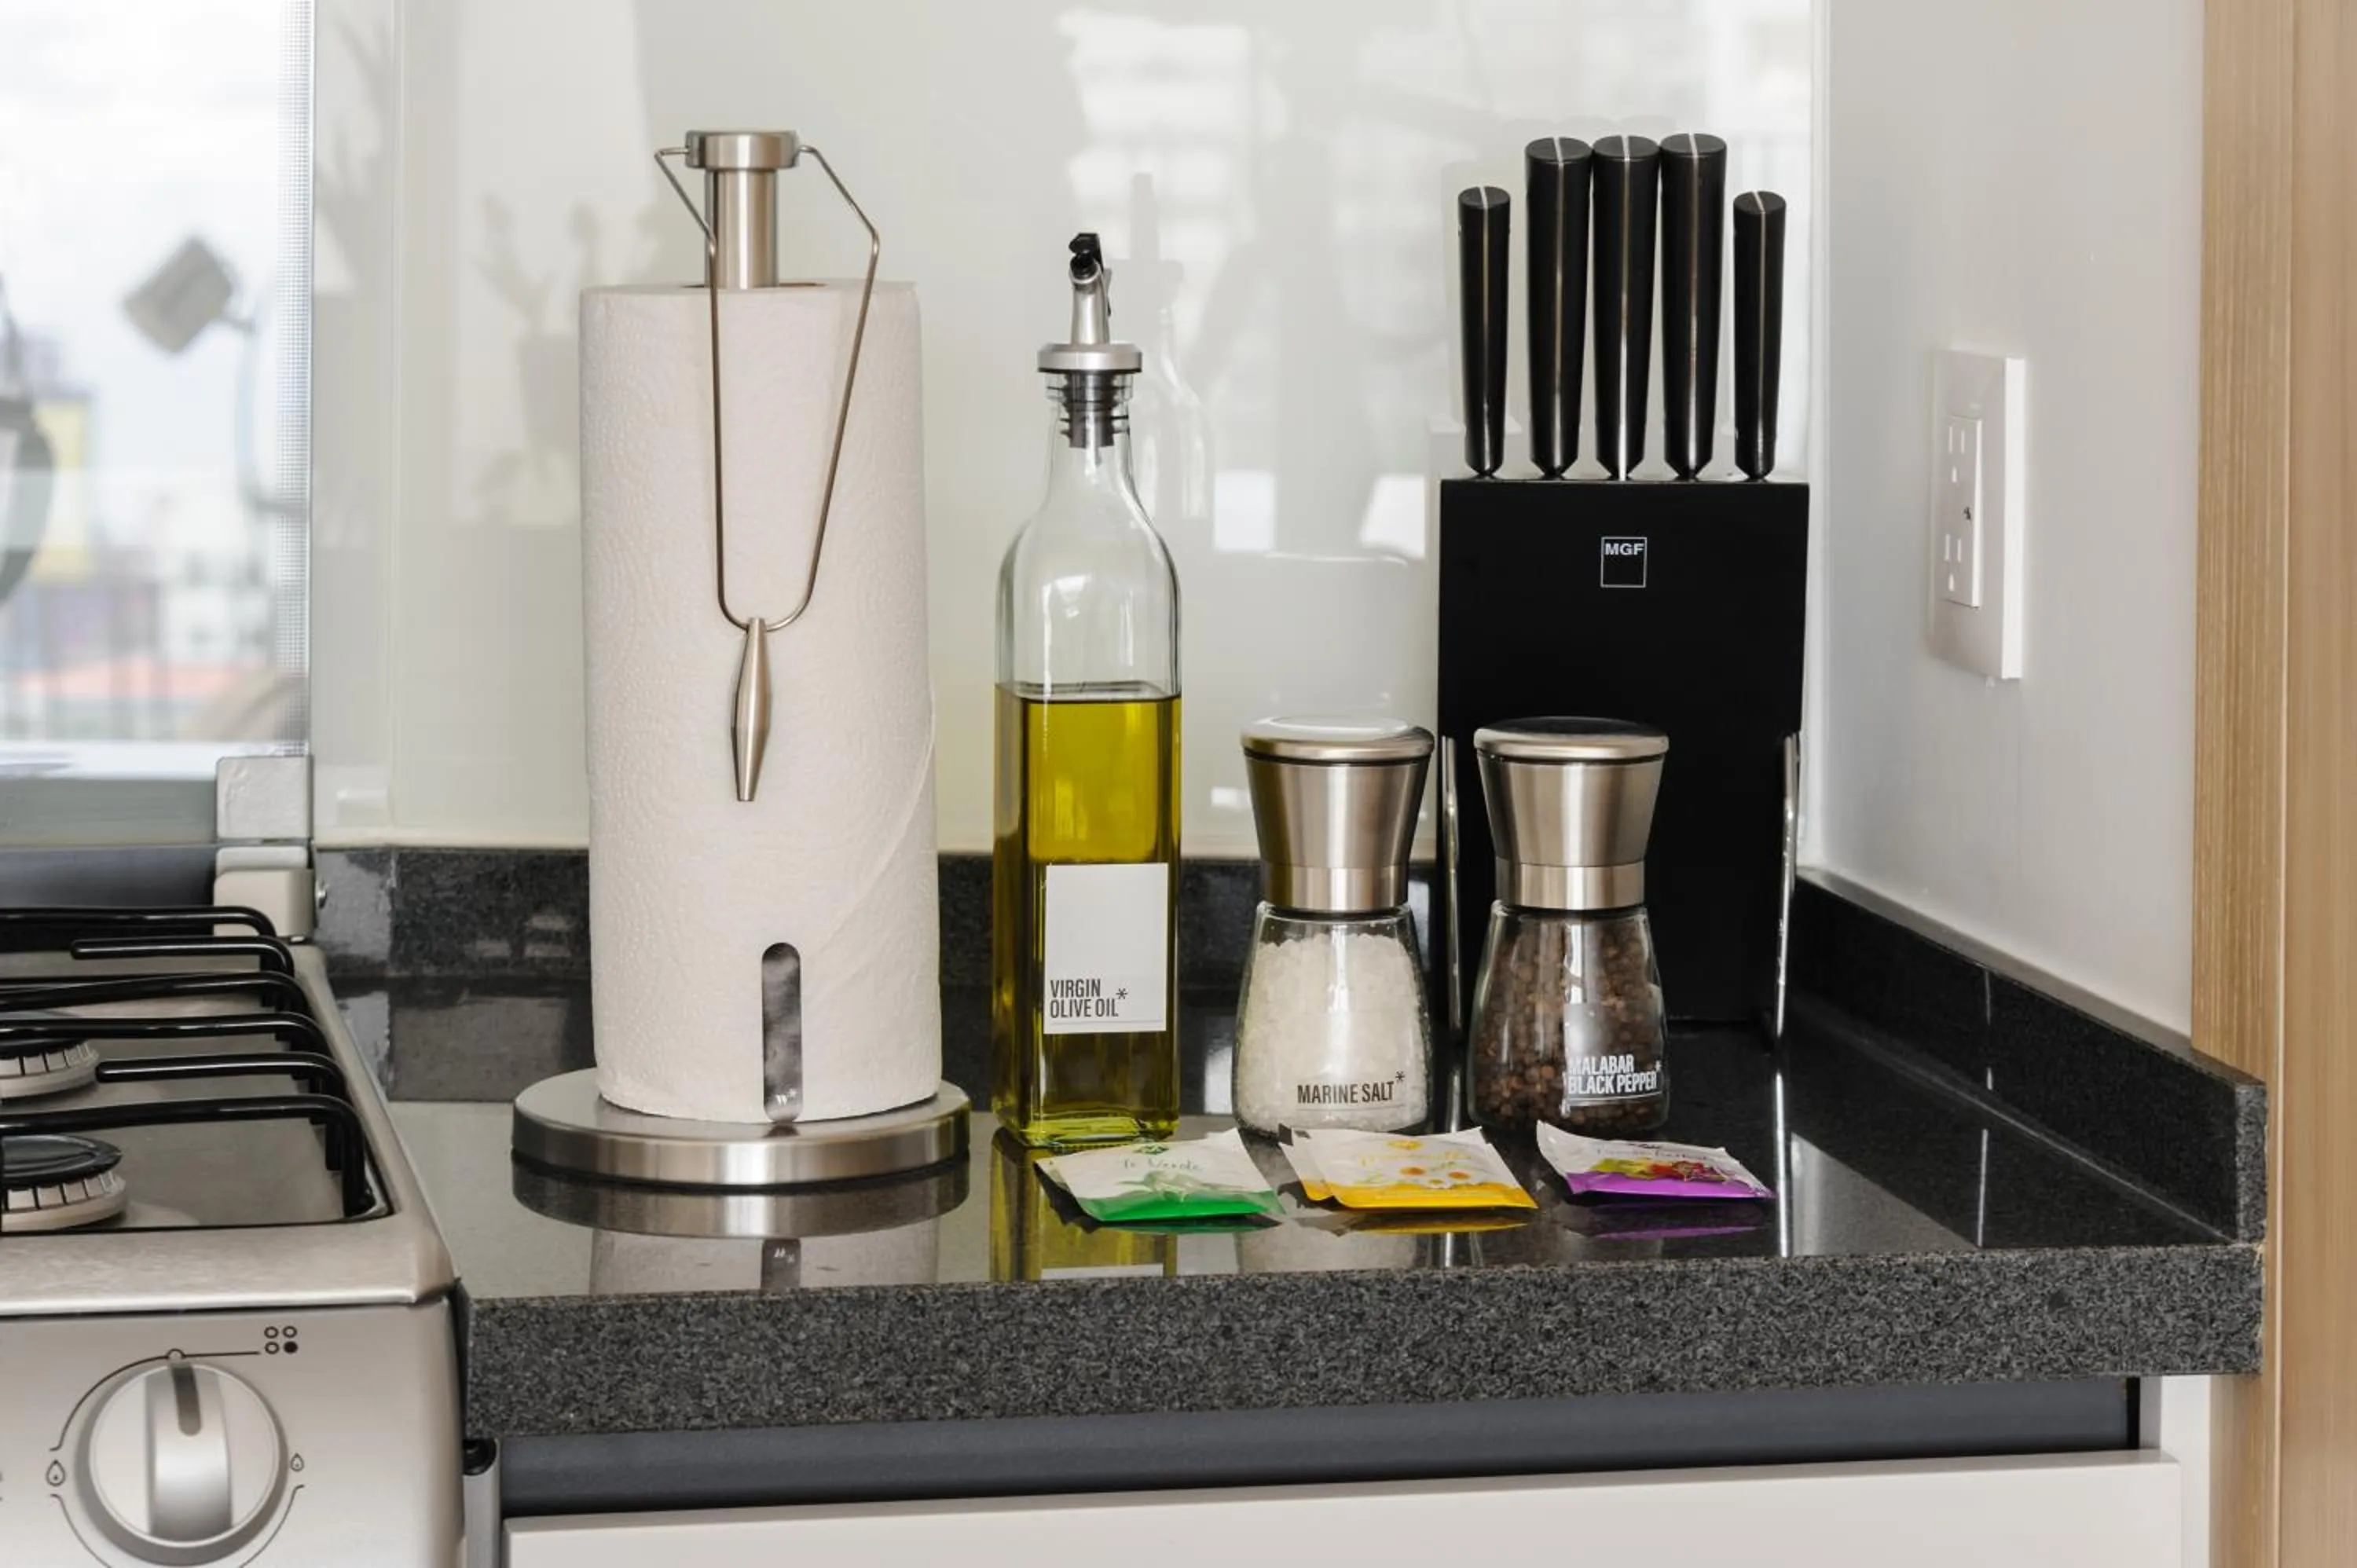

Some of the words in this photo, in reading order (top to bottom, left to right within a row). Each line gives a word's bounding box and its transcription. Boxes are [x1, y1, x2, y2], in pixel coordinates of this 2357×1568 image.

[1604, 543, 1644, 555] MGF
[1050, 979, 1101, 998] VIRGIN
[1050, 998, 1091, 1018] OLIVE
[1569, 1075, 1615, 1094] BLACK
[1617, 1071, 1657, 1093] PEPPER
[1297, 1084, 1358, 1104] MARINE
